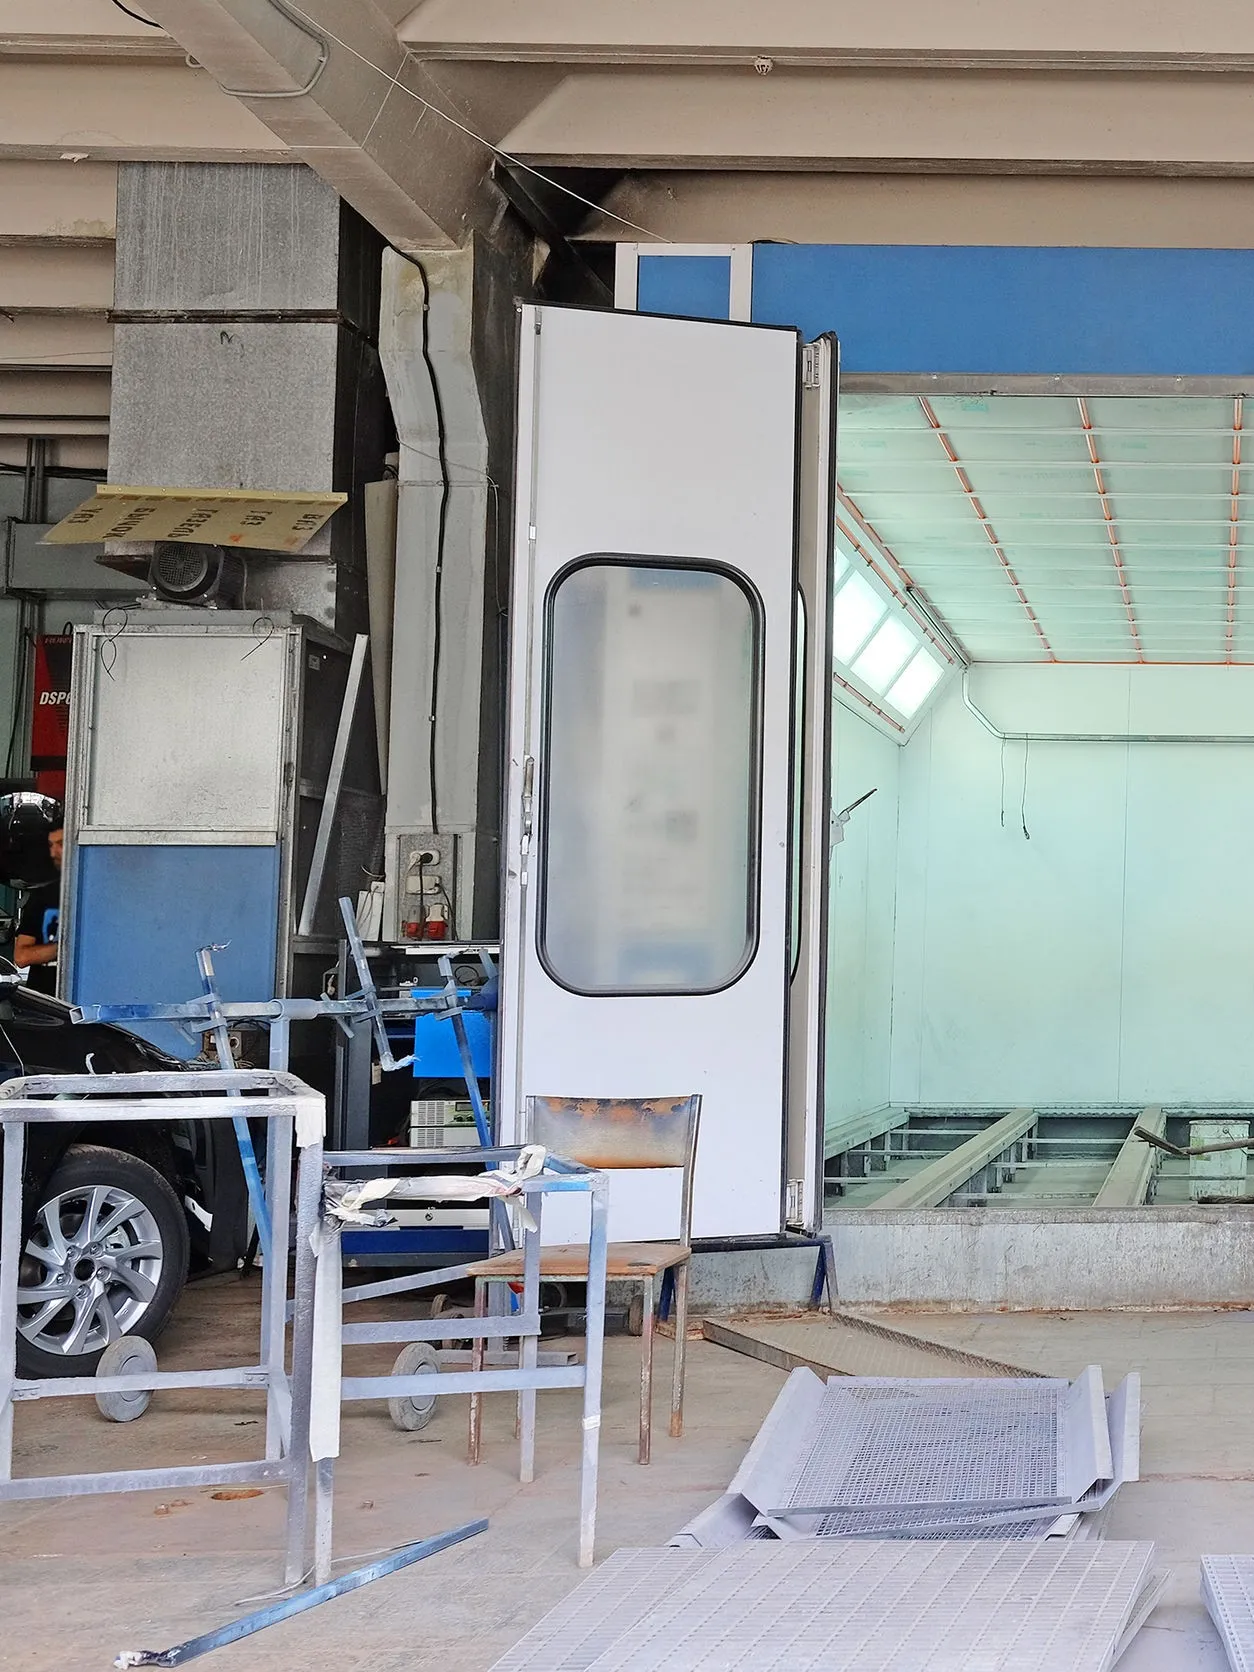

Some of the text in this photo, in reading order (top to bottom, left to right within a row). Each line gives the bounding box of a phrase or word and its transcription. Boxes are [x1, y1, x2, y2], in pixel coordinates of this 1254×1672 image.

[167, 508, 220, 538] ГАЗЕЛЬ
[240, 510, 273, 527] ГАЗ
[291, 513, 324, 531] ВАЗ
